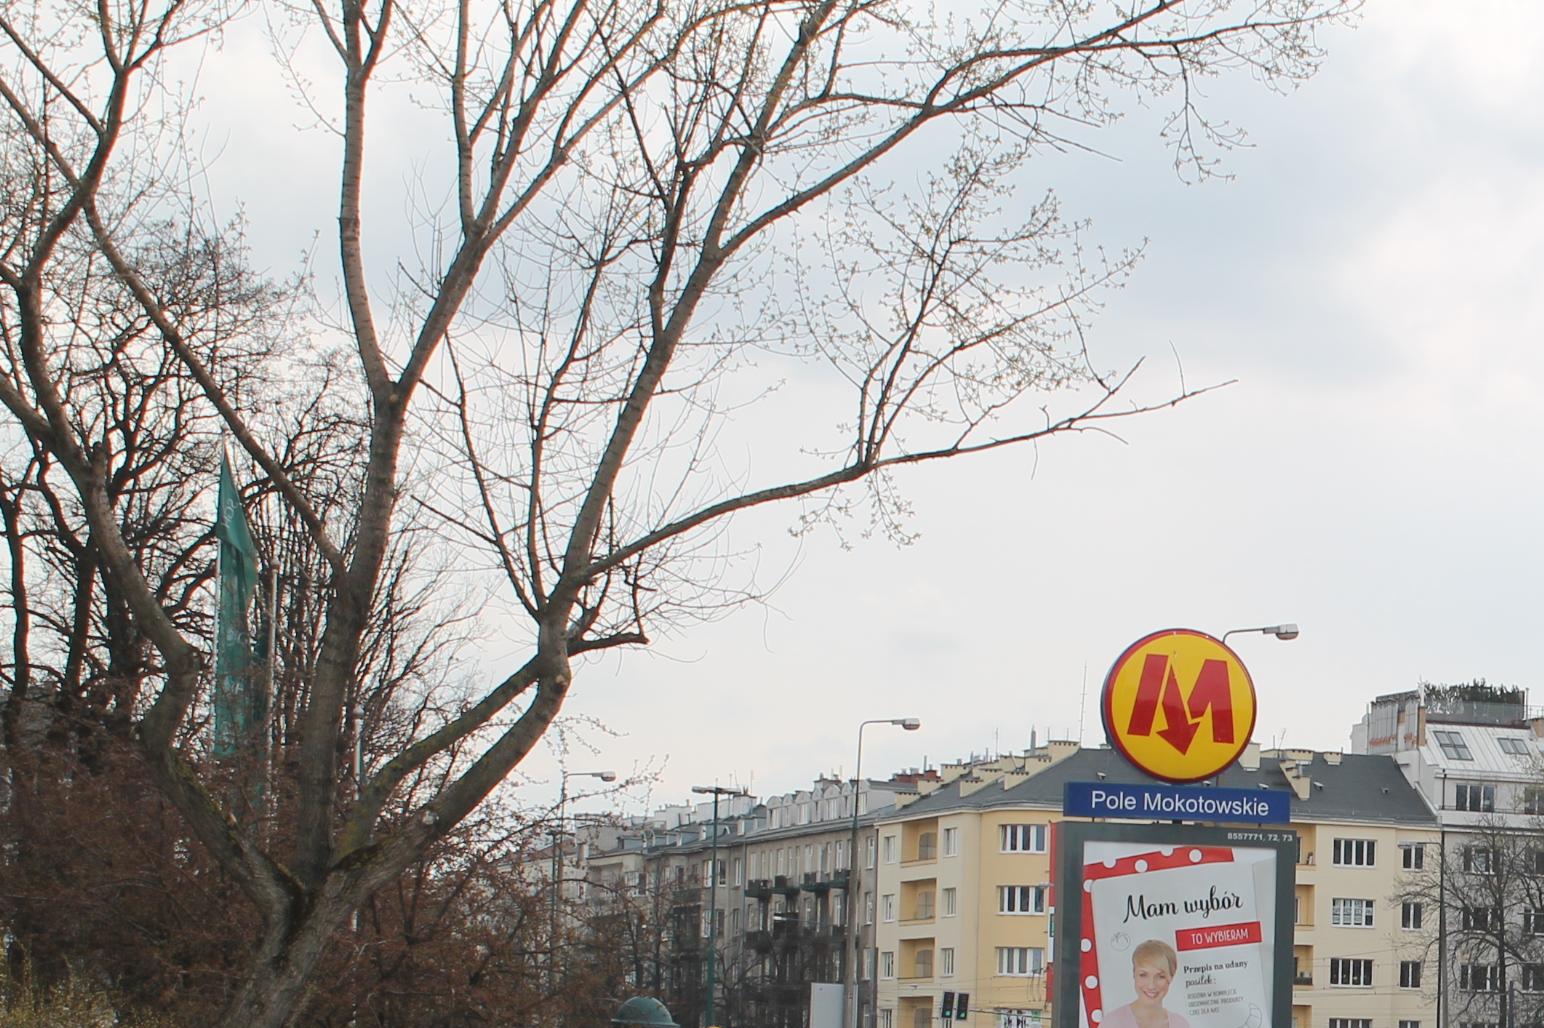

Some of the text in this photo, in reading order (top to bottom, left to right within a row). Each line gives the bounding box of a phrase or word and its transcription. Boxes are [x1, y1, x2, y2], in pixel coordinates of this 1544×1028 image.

[1127, 653, 1235, 756] M
[1091, 790, 1269, 816] Pole Mokotowskie
[1123, 885, 1243, 923] Mam wybór
[1191, 928, 1249, 945] TO WYBIERAM
